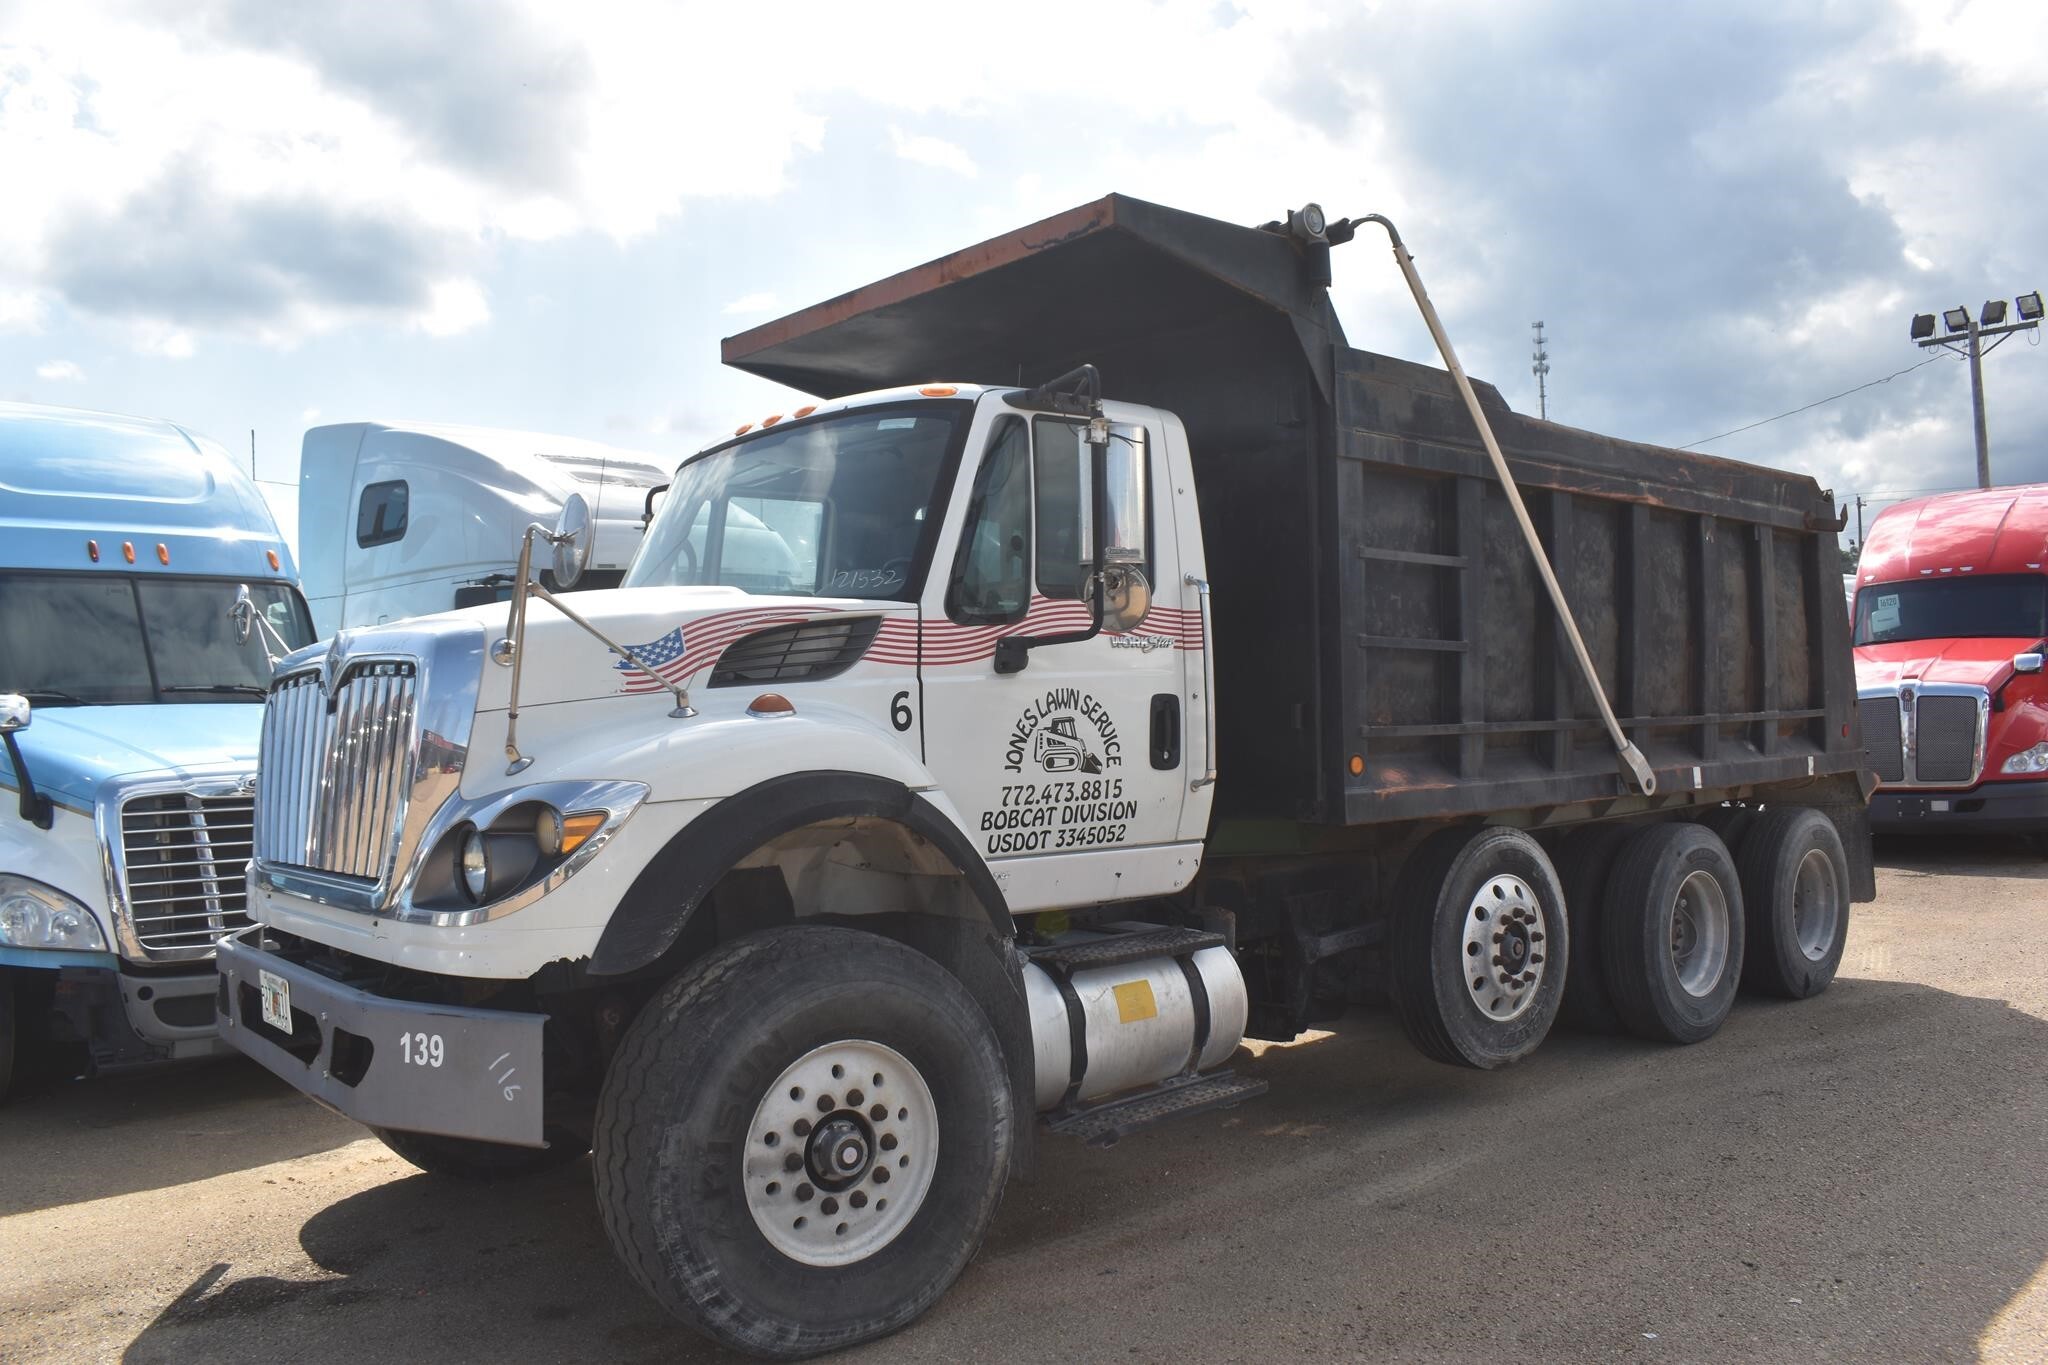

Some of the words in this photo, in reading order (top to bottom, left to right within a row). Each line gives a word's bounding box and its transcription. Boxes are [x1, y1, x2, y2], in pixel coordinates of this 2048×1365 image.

[891, 690, 912, 731] 6
[1005, 708, 1038, 773] JONES
[1035, 688, 1080, 718] LAWN
[1081, 694, 1122, 768] SERVICE
[1002, 779, 1122, 807] 772.473.8815
[981, 807, 1057, 831] BOBCAT
[1061, 800, 1138, 825] DIVISION
[987, 830, 1051, 854] USDOT
[1055, 824, 1127, 848] 3345052
[400, 1031, 444, 1068] 139
